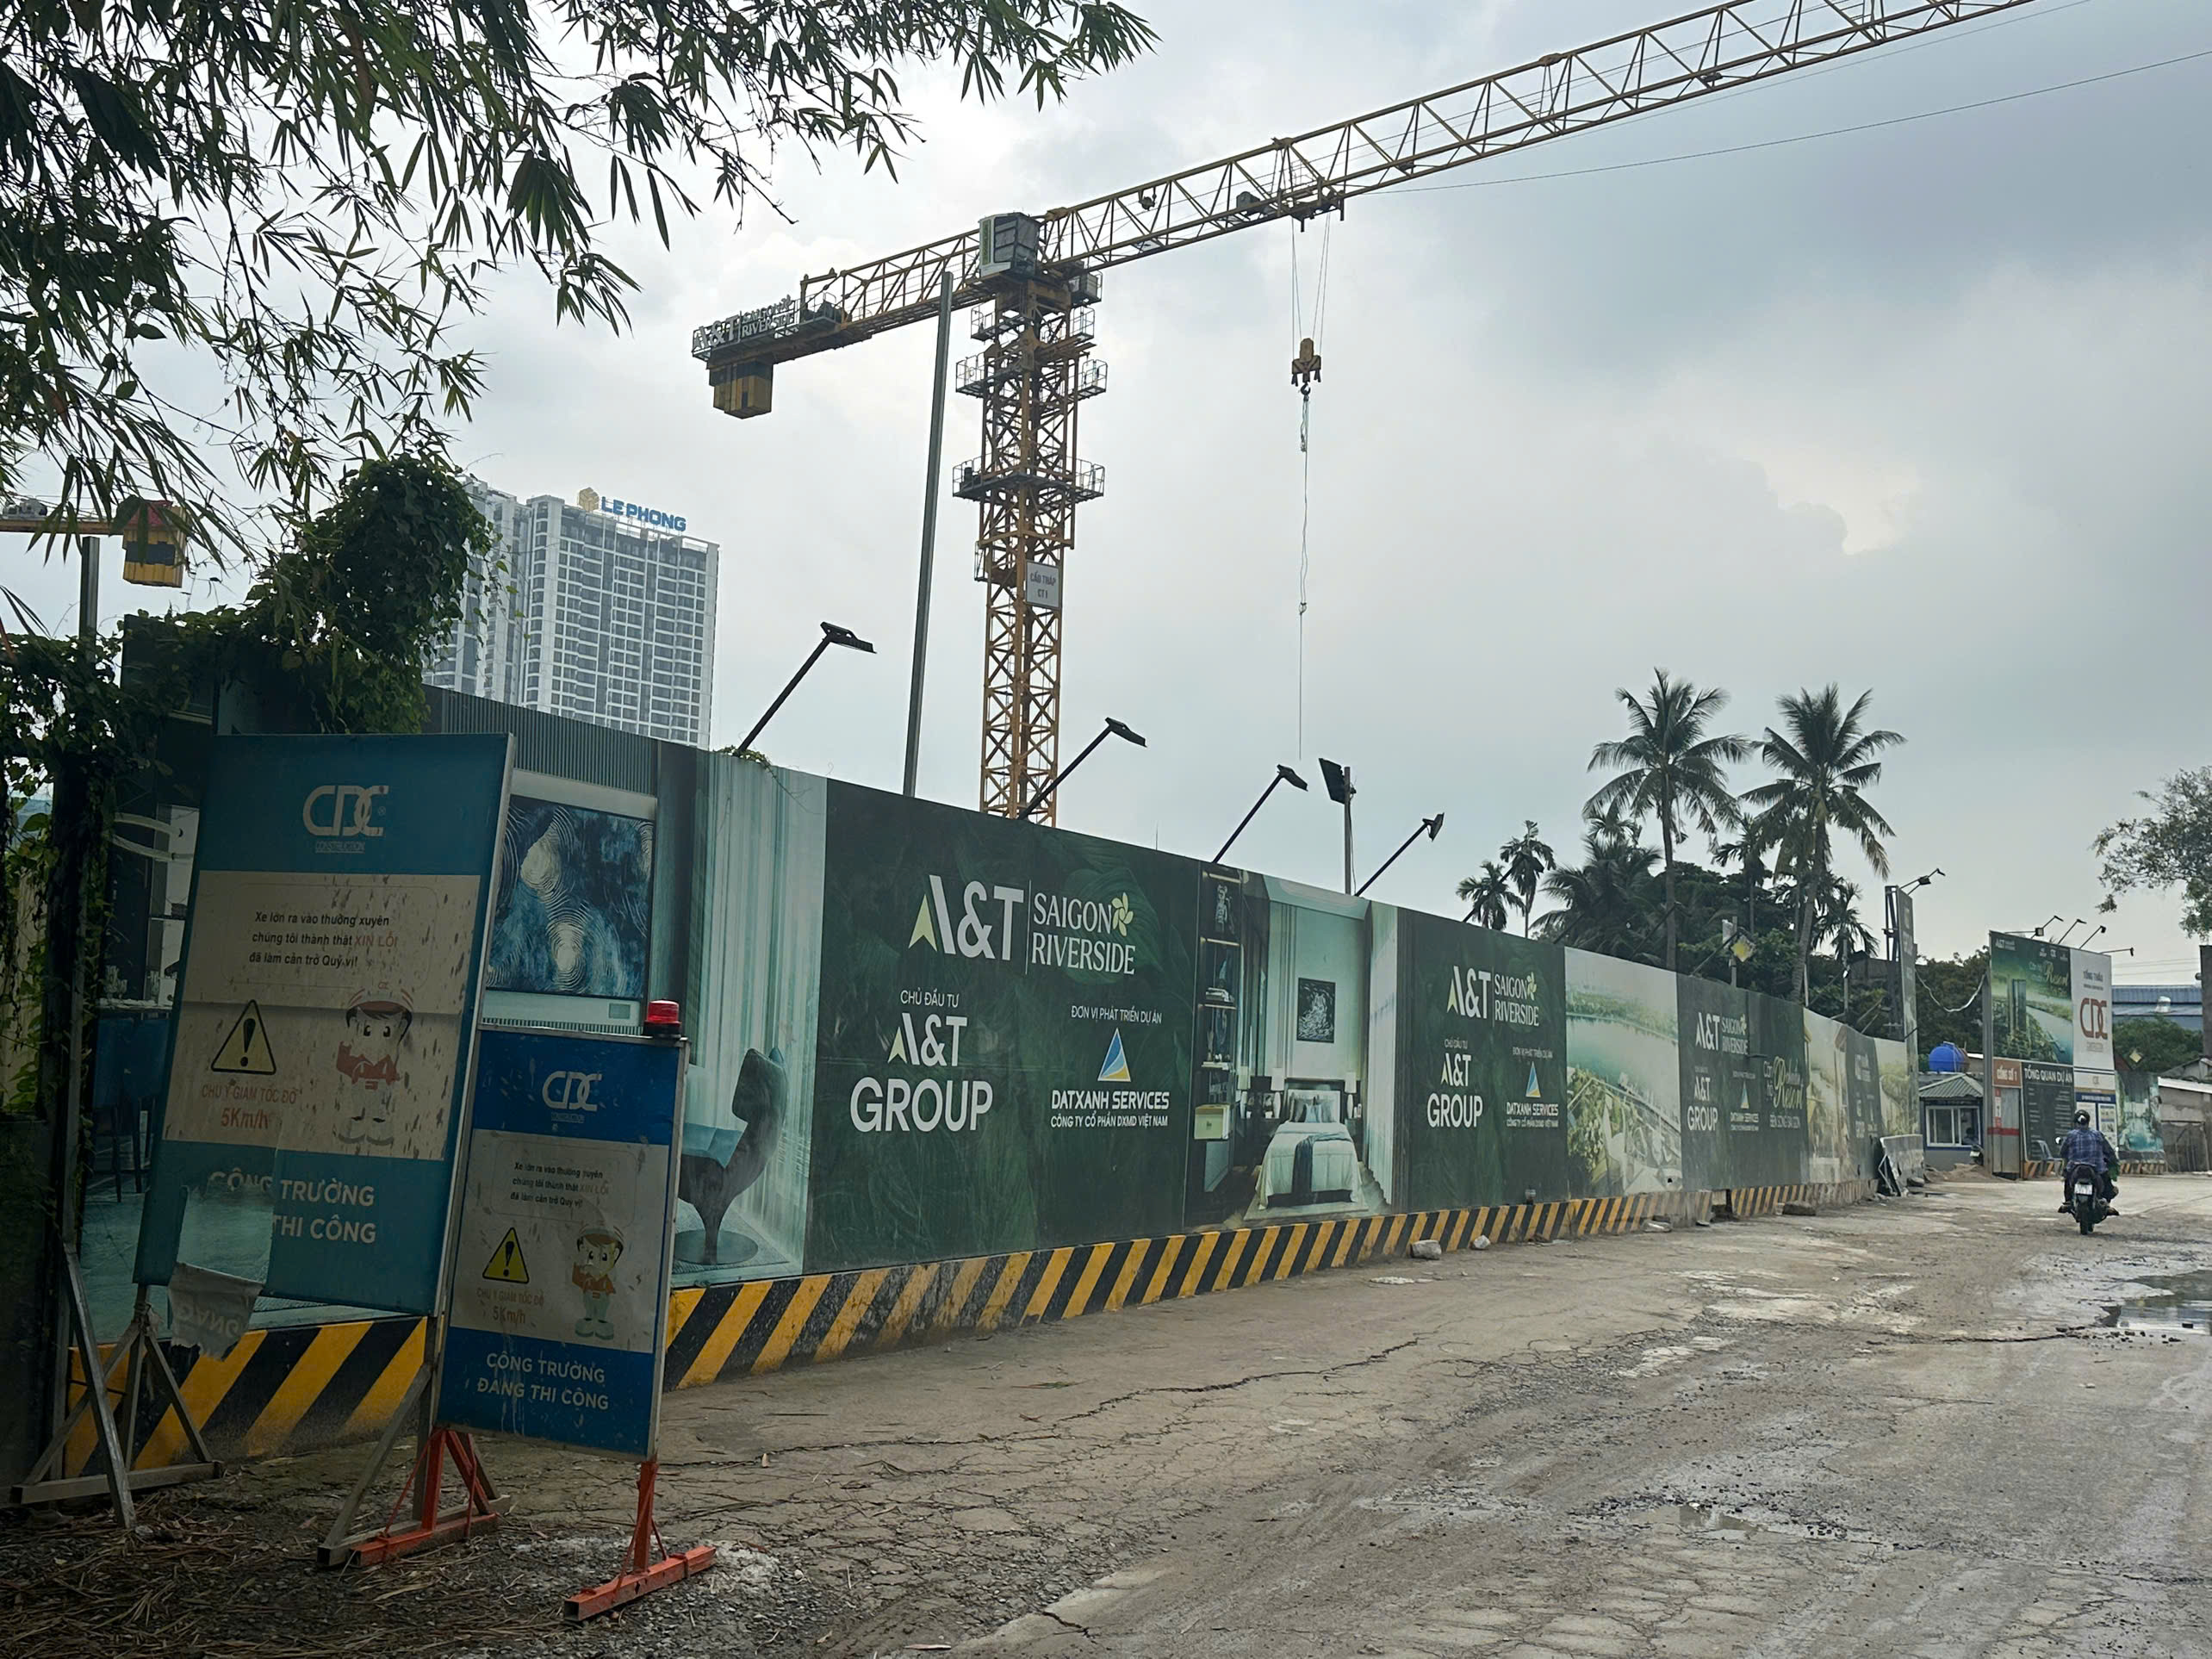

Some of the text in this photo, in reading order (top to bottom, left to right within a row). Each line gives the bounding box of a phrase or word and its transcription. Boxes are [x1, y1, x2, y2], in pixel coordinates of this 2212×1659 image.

[742, 313, 794, 338] RIVERSIDE
[626, 503, 687, 532] PHONG
[255, 912, 267, 923] Xe
[289, 915, 298, 923] ra
[908, 874, 1113, 961] A&T SAIGON
[1031, 931, 1136, 975] RIVERSIDE
[899, 986, 923, 1005] CHỦ
[947, 992, 960, 1008] TƯ
[1447, 965, 1528, 1019] A&T SAIGON
[1071, 1004, 1090, 1019] ĐƠN
[1099, 1005, 1118, 1021] PHÁT
[1152, 1009, 1163, 1024] ÁN
[1494, 999, 1540, 1027] RIVERSIDE
[886, 1012, 968, 1067] A&T
[1441, 1052, 1472, 1087] A&T
[849, 1076, 994, 1133] GROUP
[1051, 1089, 1170, 1110] DATXANH SERVICES
[1426, 1092, 1483, 1128] GROUP
[221, 1107, 270, 1130] 5Km/h
[1050, 1112, 1074, 1128] CÔNG
[1074, 1115, 1084, 1128] TY
[1084, 1109, 1097, 1128] CỔ
[1137, 1112, 1153, 1128] VIỆT
[1153, 1115, 1168, 1127] NAM
[1687, 1105, 1719, 1131] GROUP
[280, 1177, 376, 1208] TRƯỜNG
[310, 1213, 376, 1244] CÔNG
[487, 1350, 606, 1383] CÔNG TRƯỜNG
[477, 1377, 609, 1410] ĐANG THI CÔNG
